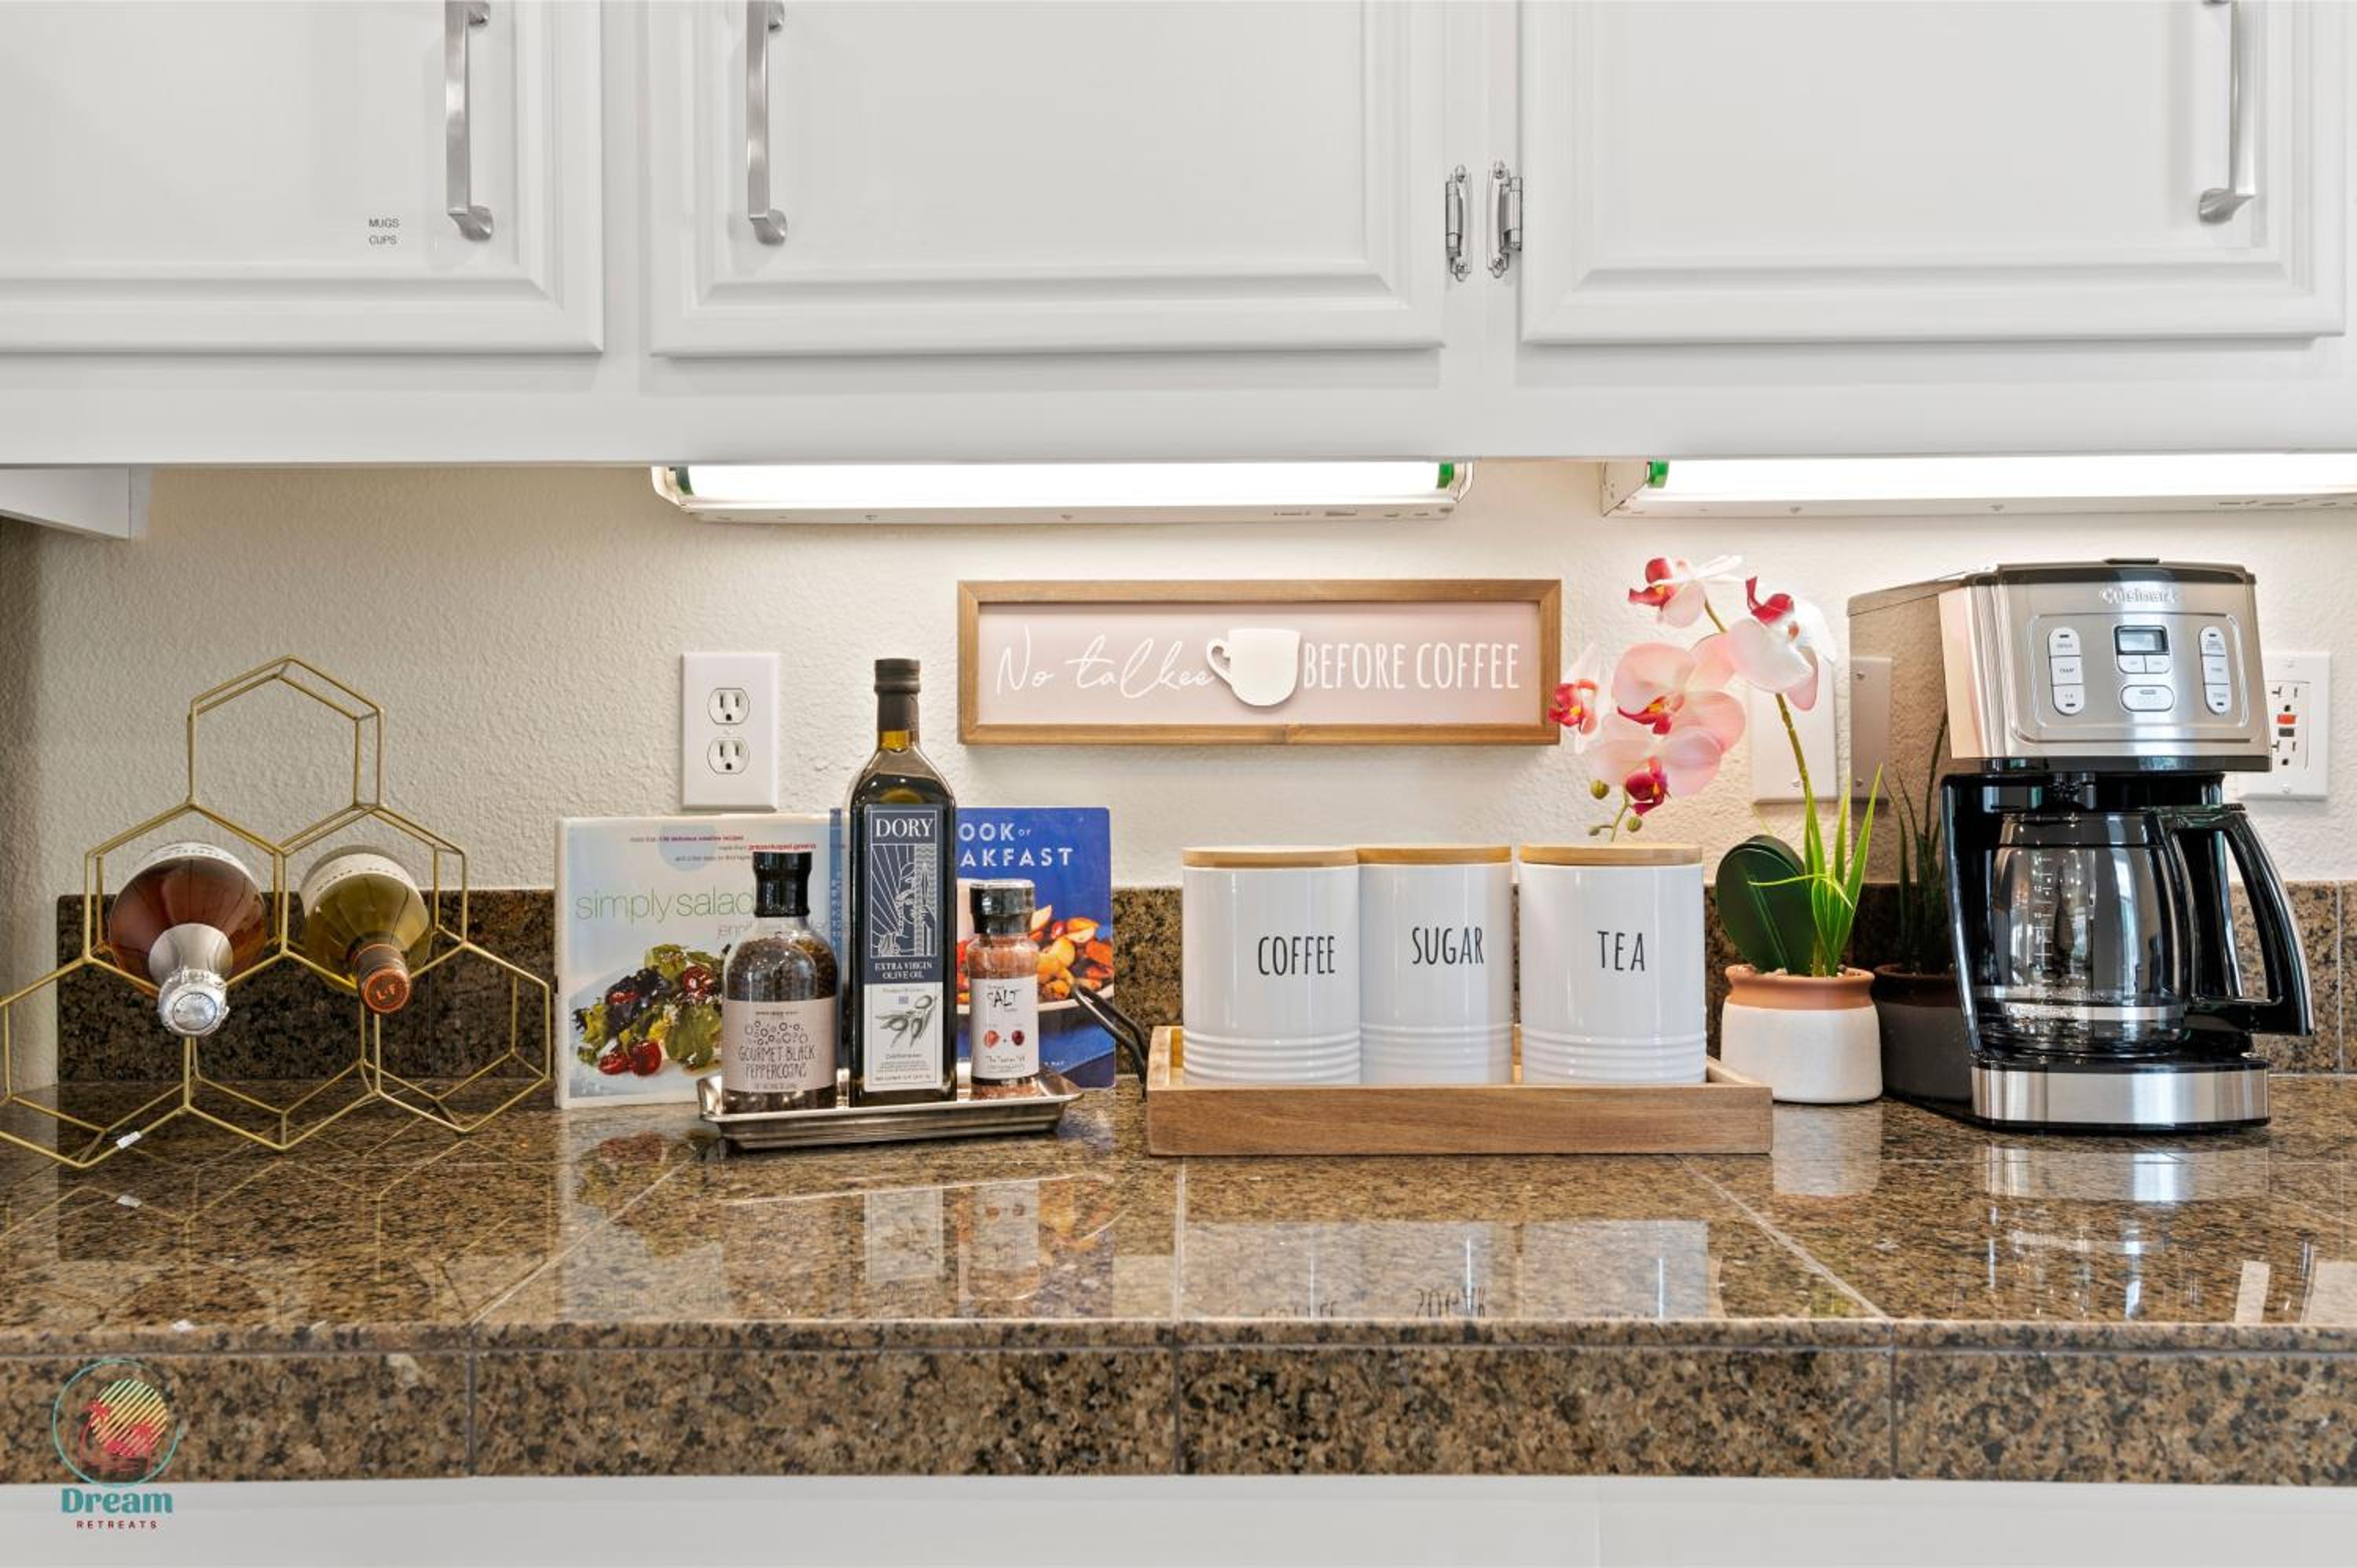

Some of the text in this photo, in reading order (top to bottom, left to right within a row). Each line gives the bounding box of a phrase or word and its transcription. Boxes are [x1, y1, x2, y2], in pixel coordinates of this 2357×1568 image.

[368, 218, 400, 228] MUGS
[368, 236, 397, 245] CUPS
[995, 625, 1520, 700] No talkee BEFORE COFFEE
[875, 818, 934, 838] DORY
[958, 822, 1015, 841] OOK
[959, 848, 1074, 867] AKFAST
[575, 885, 756, 925] simply salad
[1412, 925, 1484, 966] SUGAR
[1597, 929, 1646, 973] TEA
[1257, 935, 1336, 976] COFFEE
[874, 961, 933, 971] EXTRA VIRGIN
[882, 970, 925, 980] OLIVE OIL
[738, 1044, 816, 1062] GOURMET BLACK
